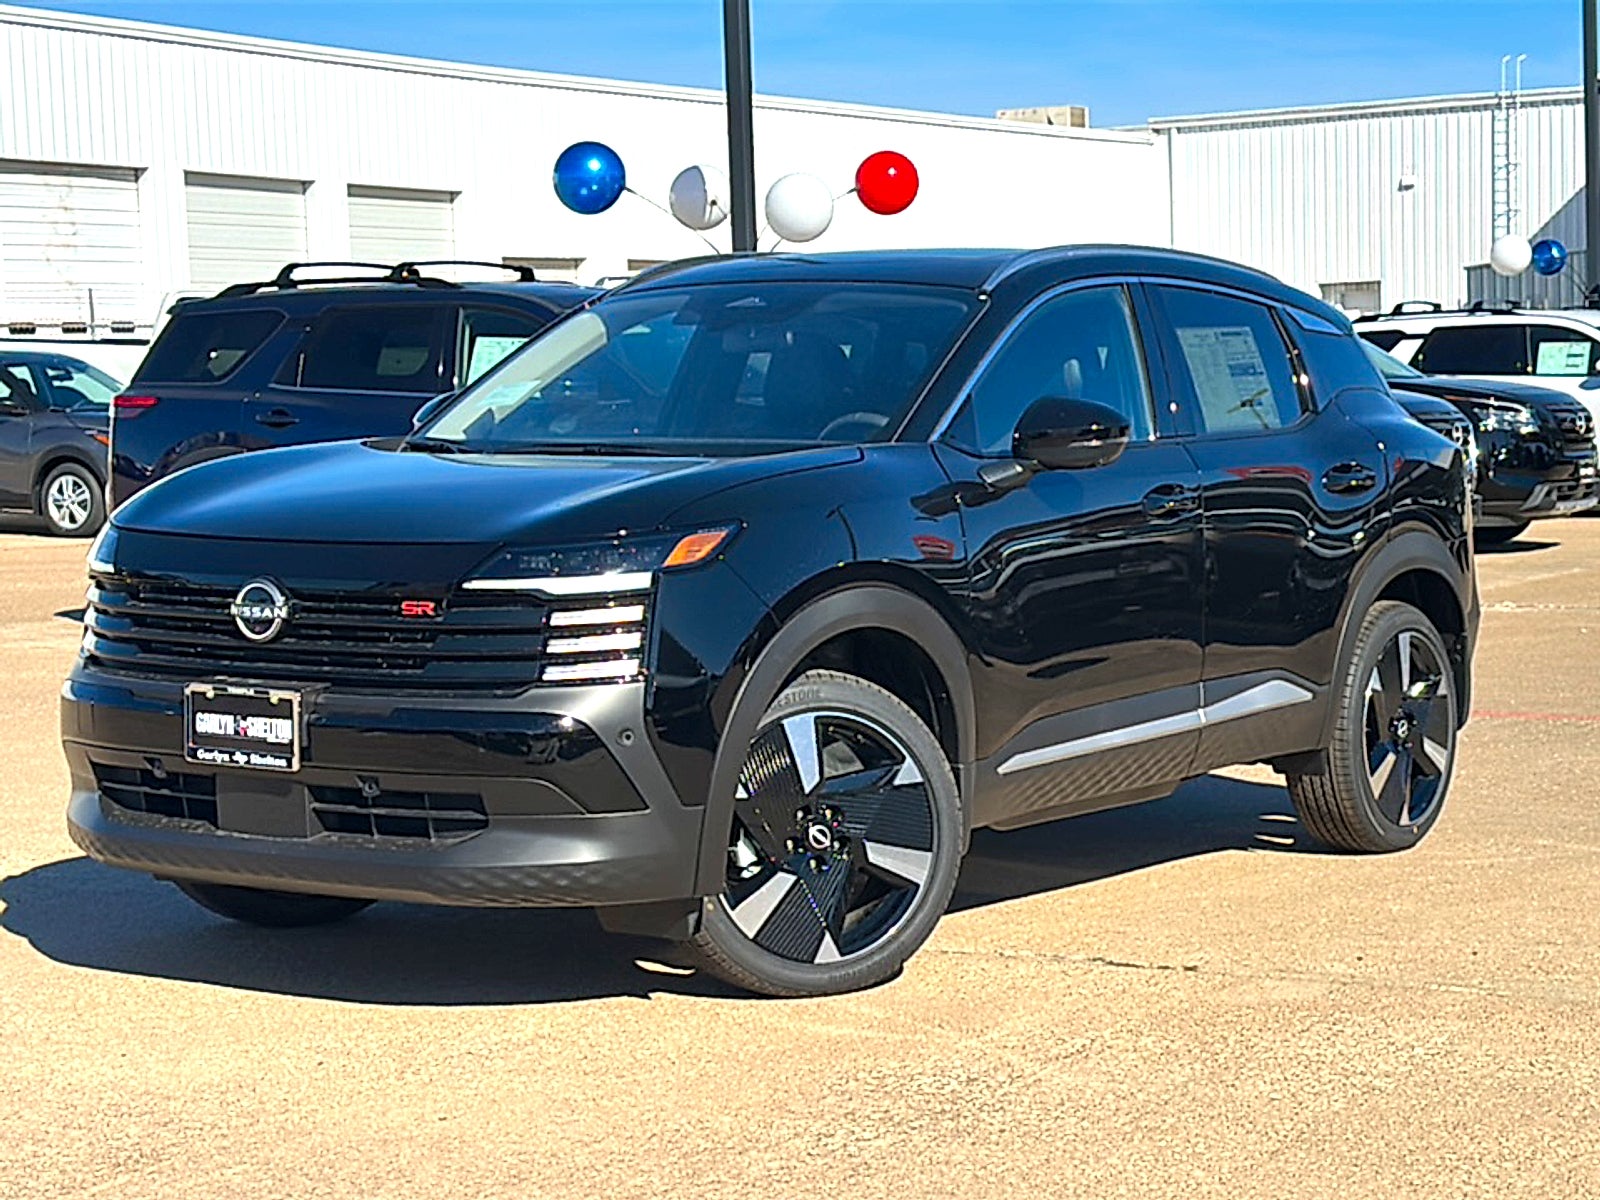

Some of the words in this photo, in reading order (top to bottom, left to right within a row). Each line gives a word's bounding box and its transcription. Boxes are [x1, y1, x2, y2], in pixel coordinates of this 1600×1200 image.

[230, 603, 287, 619] NISSAN
[401, 600, 435, 616] SR
[247, 716, 292, 740] SHELTON
